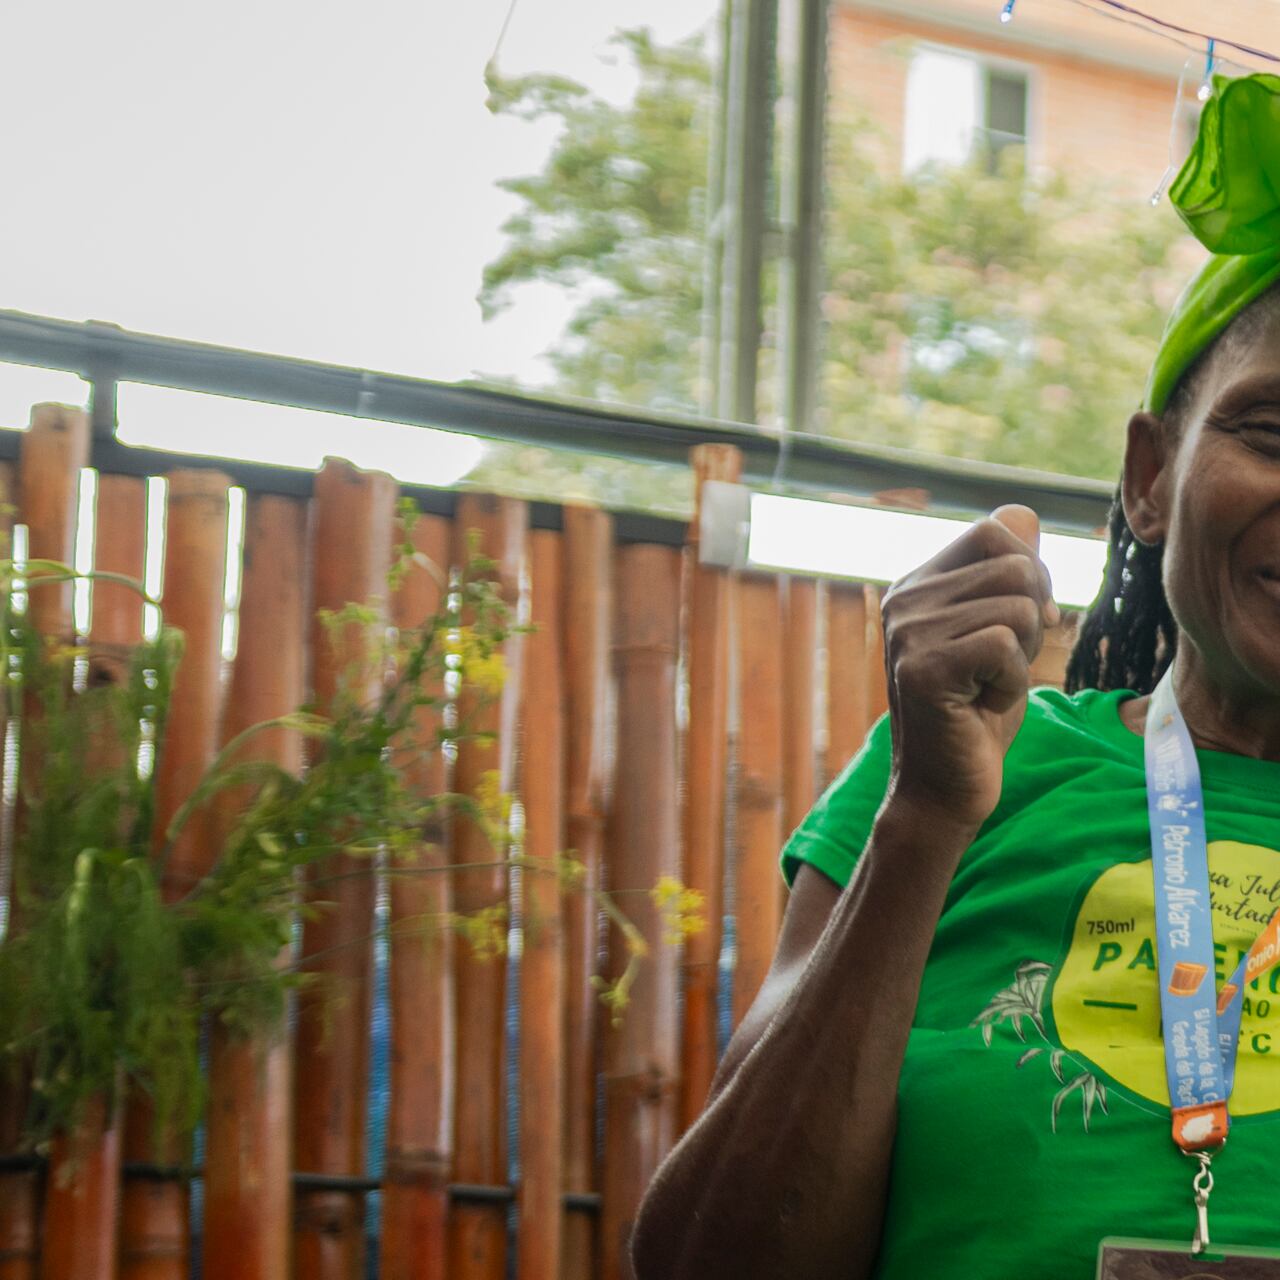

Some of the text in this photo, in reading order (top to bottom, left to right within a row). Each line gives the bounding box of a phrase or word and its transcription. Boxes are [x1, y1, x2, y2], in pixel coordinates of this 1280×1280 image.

[1209, 871, 1231, 888] na
[1210, 891, 1278, 926] urtad
[1086, 917, 1136, 936] 750ml
